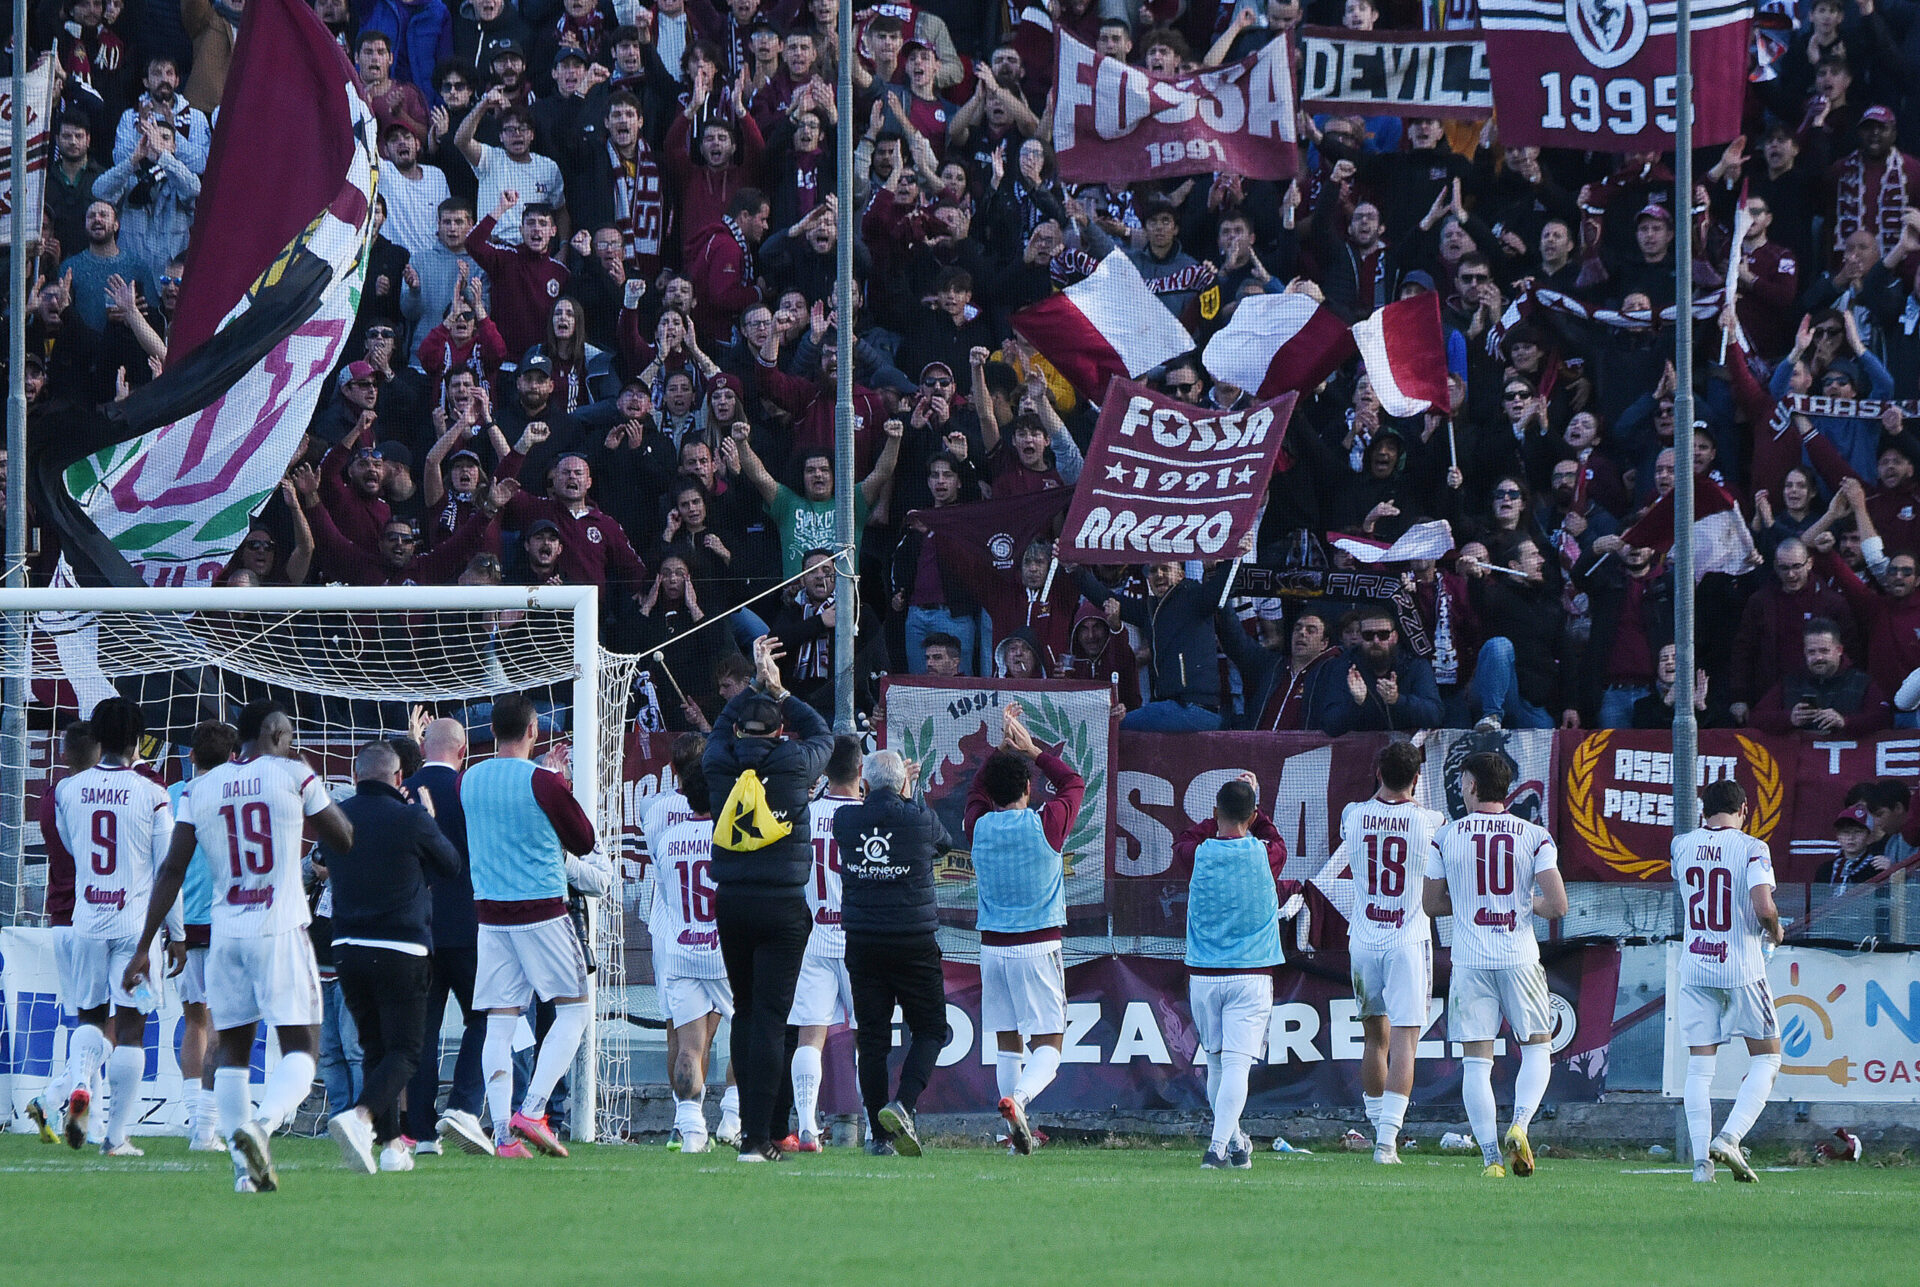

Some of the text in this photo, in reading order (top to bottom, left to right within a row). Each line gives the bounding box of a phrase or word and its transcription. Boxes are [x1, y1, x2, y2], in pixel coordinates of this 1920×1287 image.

[1053, 28, 1296, 153] FOSSA
[1540, 71, 1695, 135] 1995
[1144, 138, 1227, 168] 1991
[1120, 395, 1275, 452] FOSSA
[1132, 465, 1233, 493] 1991
[1074, 506, 1234, 554] AREZZO
[946, 691, 999, 721] 1991
[81, 787, 131, 806] SAMAKE
[222, 777, 262, 799] DIALLO
[91, 809, 117, 876] 9
[218, 802, 275, 878] 19
[1362, 815, 1409, 832] DAMIANI
[1457, 819, 1524, 836] PATTARELLO
[1362, 834, 1408, 898] 18
[1471, 834, 1514, 896] 10
[1696, 845, 1722, 862] ZONA
[1685, 866, 1732, 932] 20
